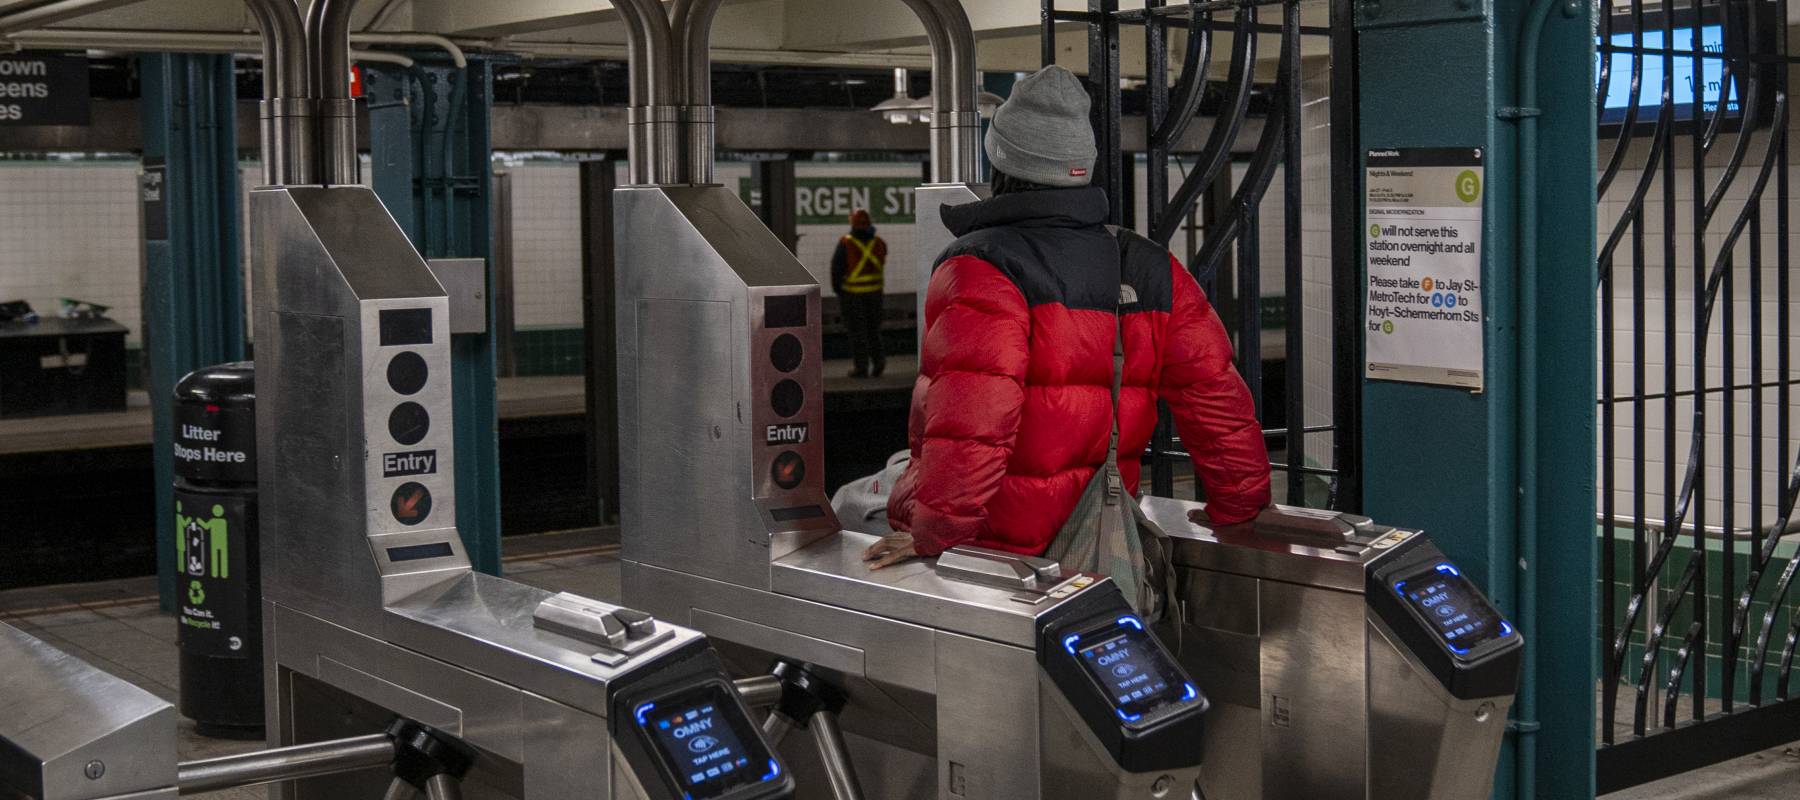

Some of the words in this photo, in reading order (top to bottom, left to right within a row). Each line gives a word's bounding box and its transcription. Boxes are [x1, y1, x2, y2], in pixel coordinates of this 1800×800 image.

[796, 186, 870, 216] RGEN
[1382, 225, 1396, 236] will
[1398, 226, 1414, 237] not
[1414, 228, 1440, 238] serve
[1440, 226, 1458, 238] this
[1369, 240, 1400, 251] station
[1400, 241, 1444, 255] overnight
[1444, 242, 1463, 254] and
[1464, 242, 1476, 254] all
[1370, 255, 1410, 266] weekend
[1370, 276, 1398, 288] Please
[1400, 278, 1420, 289] take
[1435, 280, 1446, 290] to
[1446, 279, 1463, 293] Jay
[1370, 290, 1416, 304] MetroTech
[1416, 294, 1430, 304] for
[1458, 296, 1468, 306] to
[1463, 310, 1480, 322] Sts
[1368, 320, 1381, 332] for
[182, 424, 222, 441] Litter
[767, 425, 807, 443] Entry
[203, 446, 246, 463] Here
[384, 453, 434, 474] Entry
[1422, 592, 1449, 608] OMNY
[1098, 648, 1129, 666] OMNY
[1118, 680, 1132, 689] TAP
[1132, 673, 1149, 684] HERE
[673, 717, 713, 739] OMNY
[692, 754, 708, 766] TAP
[708, 747, 731, 761] HERE
